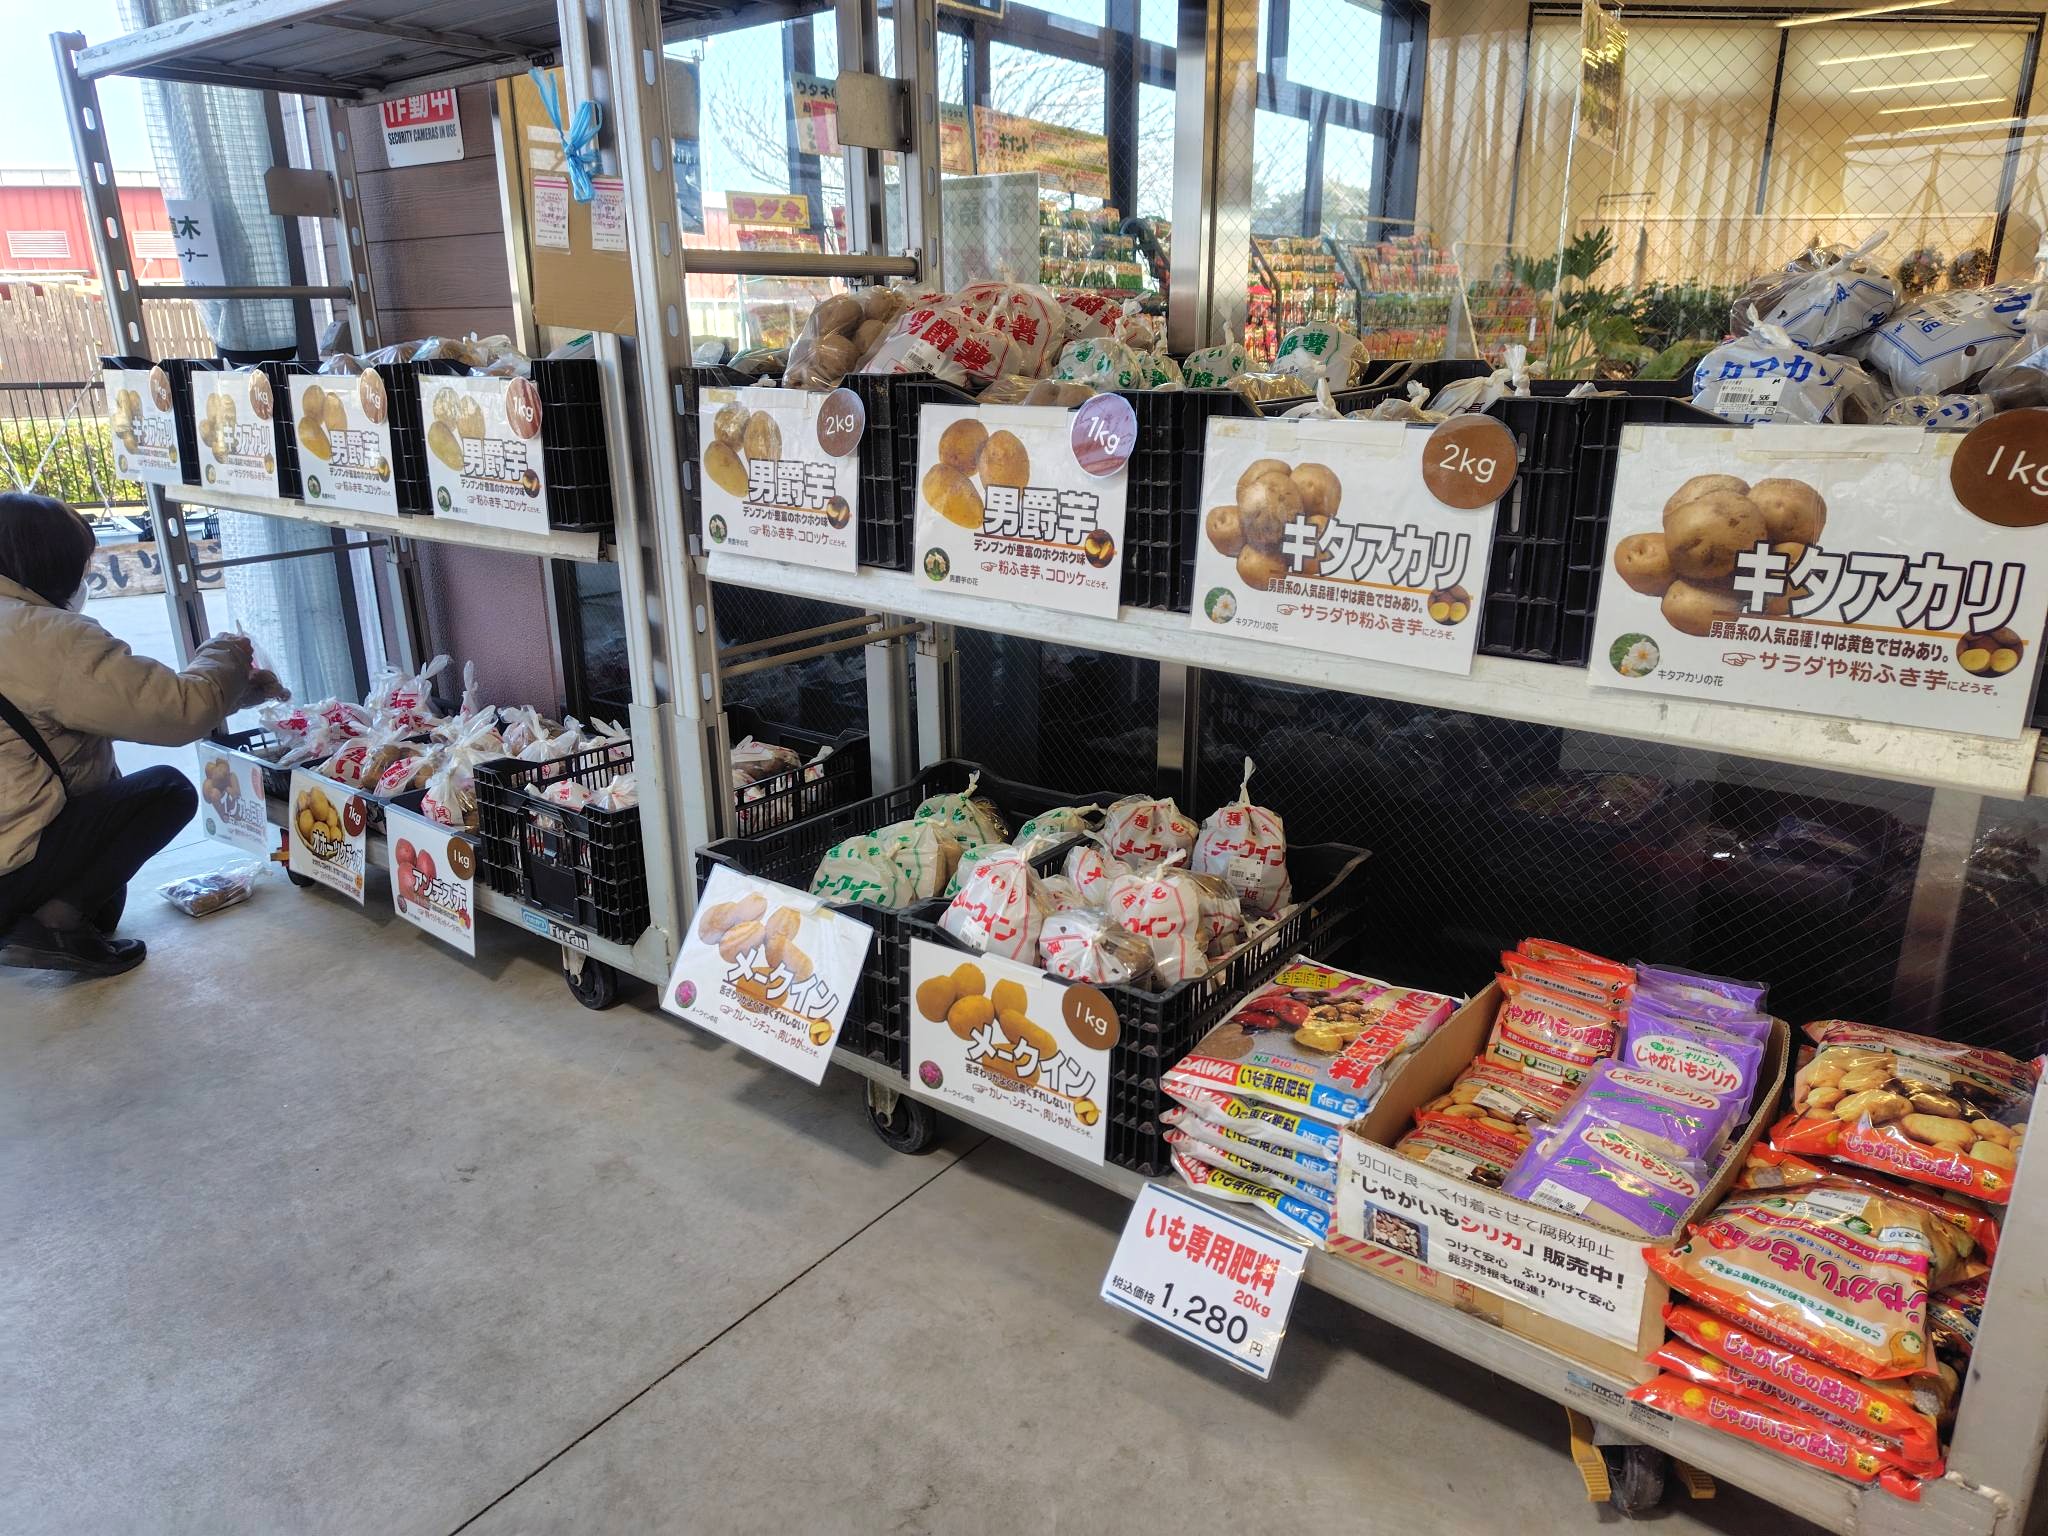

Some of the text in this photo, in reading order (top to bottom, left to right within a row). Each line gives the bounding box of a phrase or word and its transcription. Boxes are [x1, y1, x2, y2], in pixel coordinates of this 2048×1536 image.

[388, 124, 457, 145] SECURITY CAMERAS IN USE
[254, 386, 269, 405] 1kg
[365, 383, 382, 409] 1kg
[513, 395, 535, 422] 1kg
[133, 416, 174, 449] キタアカリ
[222, 422, 272, 457] キタアカリ
[825, 415, 855, 436] 2kg
[1088, 416, 1121, 455] 1kg
[329, 429, 381, 468] 男爵芋
[462, 436, 529, 482] 男爵芋
[1440, 443, 1497, 484] 2kg
[748, 459, 839, 510] 男爵芋
[743, 507, 829, 528] デンプンが豊富のホクホク味
[982, 484, 1101, 545] 男爵芋
[974, 538, 1087, 566] デンプンが豊富のホクホク味
[1282, 513, 1472, 591] キタアカリ
[1268, 579, 1425, 613] 男爵系の人気品種!中は黄色で甘みあり。
[1733, 540, 2026, 635] キタアカリ
[1235, 617, 1280, 632] キタアカリの花
[1300, 604, 1457, 642] サラダや粉ふき芋にどうぞ。
[1710, 621, 1951, 663] 男爵系の人気品種!中は黄色で甘みあり。
[1657, 669, 1725, 687] キタアカリの花
[1759, 651, 1999, 698] サラダや粉ふき芋にどうぞ。
[348, 804, 363, 827] 1kg
[453, 849, 470, 869] 1kg
[411, 868, 468, 913] アンデス赤
[727, 947, 840, 1020] メークイン
[1076, 1001, 1108, 1037] 1kg
[967, 1022, 1096, 1099] メークイン
[1270, 1057, 1292, 1070] P10
[1635, 1044, 1738, 1090] じゃがいもシリカ
[1177, 1057, 1234, 1082] DAIWA
[1240, 1066, 1311, 1099] いも専用肥料
[1317, 1091, 1341, 1112] NET
[1302, 1130, 1325, 1145] NET
[1302, 1158, 1326, 1173] NET
[1585, 1130, 1696, 1197] じゃがいもシリカ
[1846, 1135, 1974, 1186] じゃがいもの肥料
[1283, 1201, 1308, 1218] NET
[1303, 1183, 1326, 1199] NET
[1144, 1207, 1281, 1298] いも専用肥料
[1444, 1237, 1617, 1312] つけて安心 ふりかけて安心
[1112, 1274, 1264, 1357] 税込価格 1,280 円
[1233, 1289, 1272, 1318] 20kg
[1723, 1331, 1863, 1414] じゃがいもの肥料
[1708, 1395, 1849, 1467] じゃがいもの肥料
